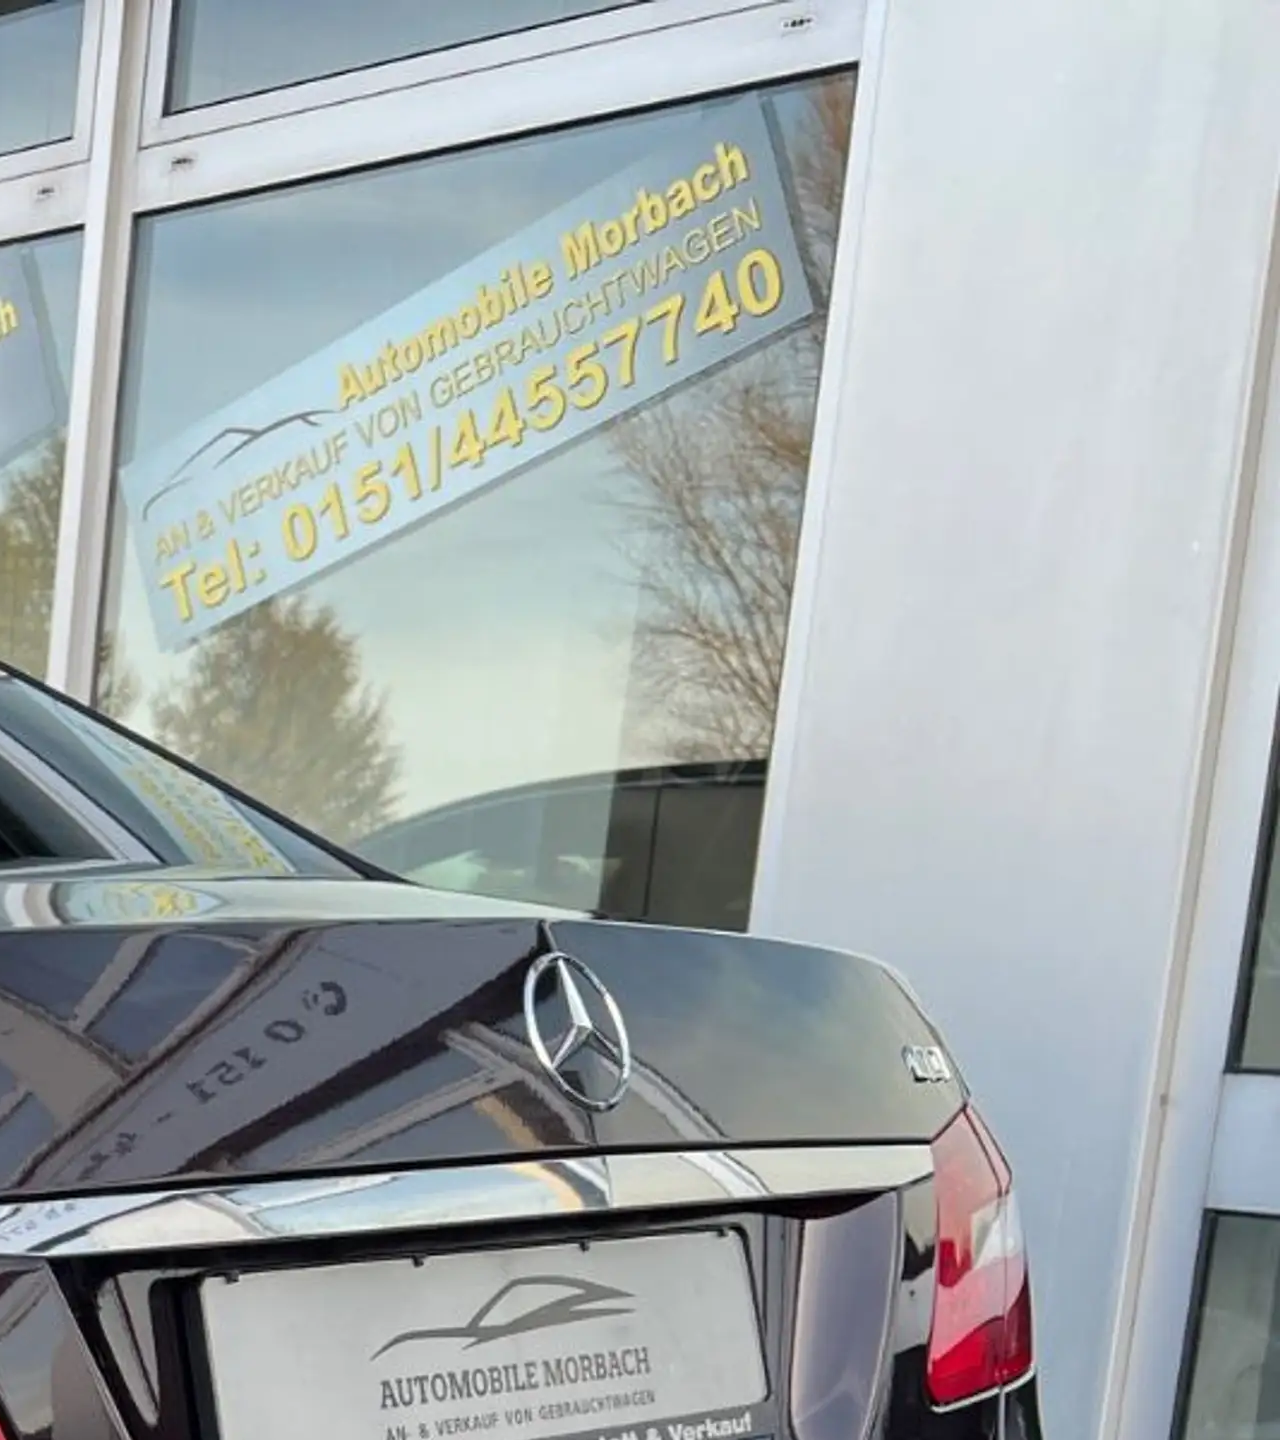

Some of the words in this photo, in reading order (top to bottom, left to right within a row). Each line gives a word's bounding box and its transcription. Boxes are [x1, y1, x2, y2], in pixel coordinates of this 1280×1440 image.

[155, 521, 191, 564] AN
[197, 510, 216, 541] &
[218, 432, 349, 524] VERKAUF
[355, 390, 423, 448] VON
[429, 198, 762, 407] GEBRAUCHTWAGEN
[338, 257, 553, 411] Automobile
[560, 142, 749, 280] Morbach
[159, 539, 268, 623] Tel:
[282, 248, 783, 562] 0151/44557740
[380, 1360, 540, 1410] AUTOMOBILE
[542, 1346, 652, 1389] MORBACH
[418, 1422, 430, 1439] &
[434, 1412, 500, 1437] VERKAUF
[504, 1408, 533, 1427] VON
[538, 1389, 657, 1421] GEBRAUCHTWAGEN
